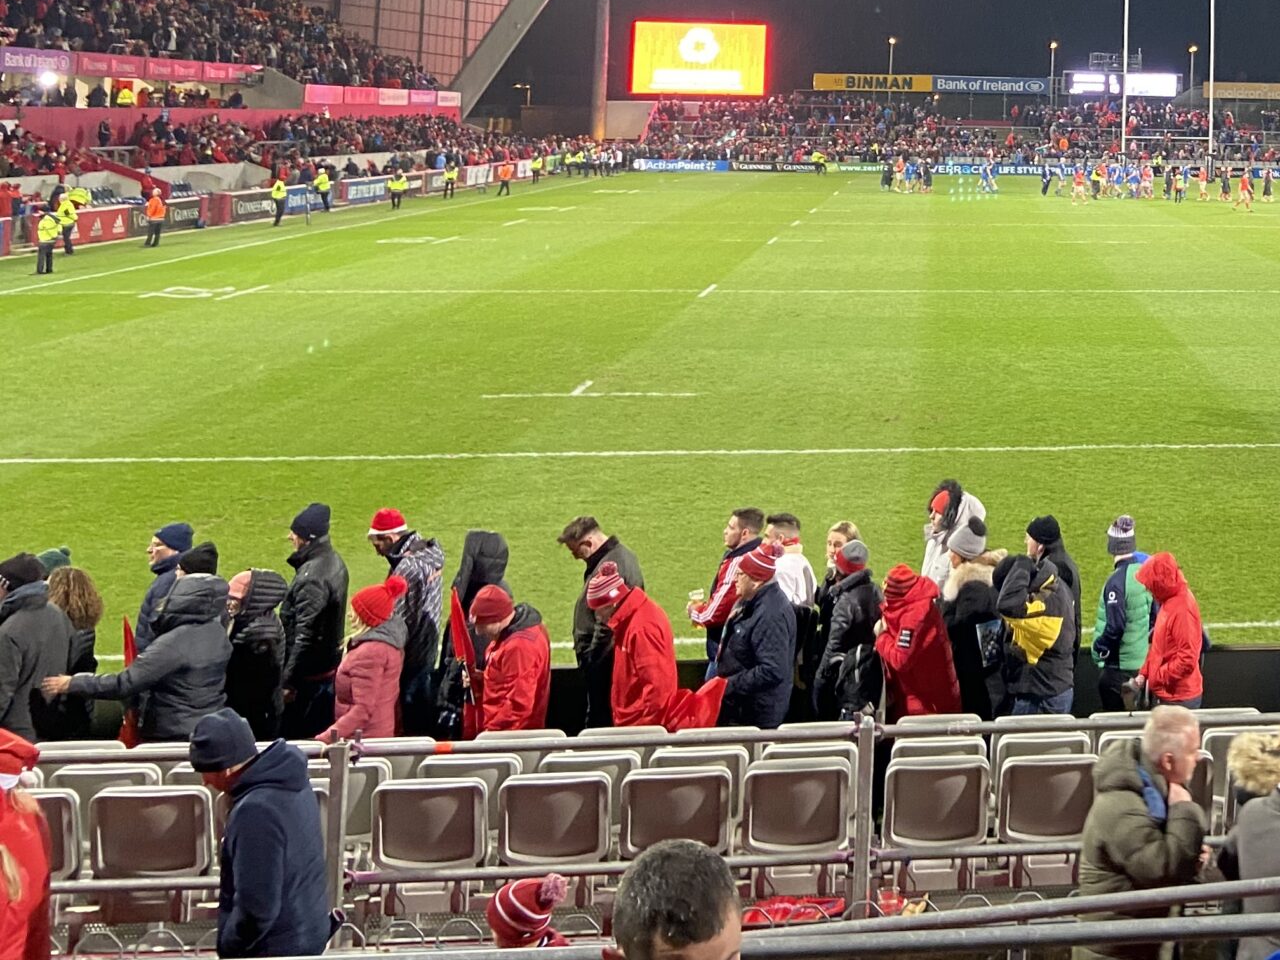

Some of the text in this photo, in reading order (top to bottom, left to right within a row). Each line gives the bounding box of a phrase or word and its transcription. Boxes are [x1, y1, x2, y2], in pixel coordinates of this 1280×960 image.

[845, 75, 913, 90] BINMAN
[937, 78, 1024, 92] Bank of Ireland
[1216, 87, 1263, 98] maldron
[645, 160, 705, 171] ActionPoint
[739, 163, 773, 171] GUINNESS
[999, 166, 1016, 175] LIFE
[1017, 166, 1043, 175] STYLE
